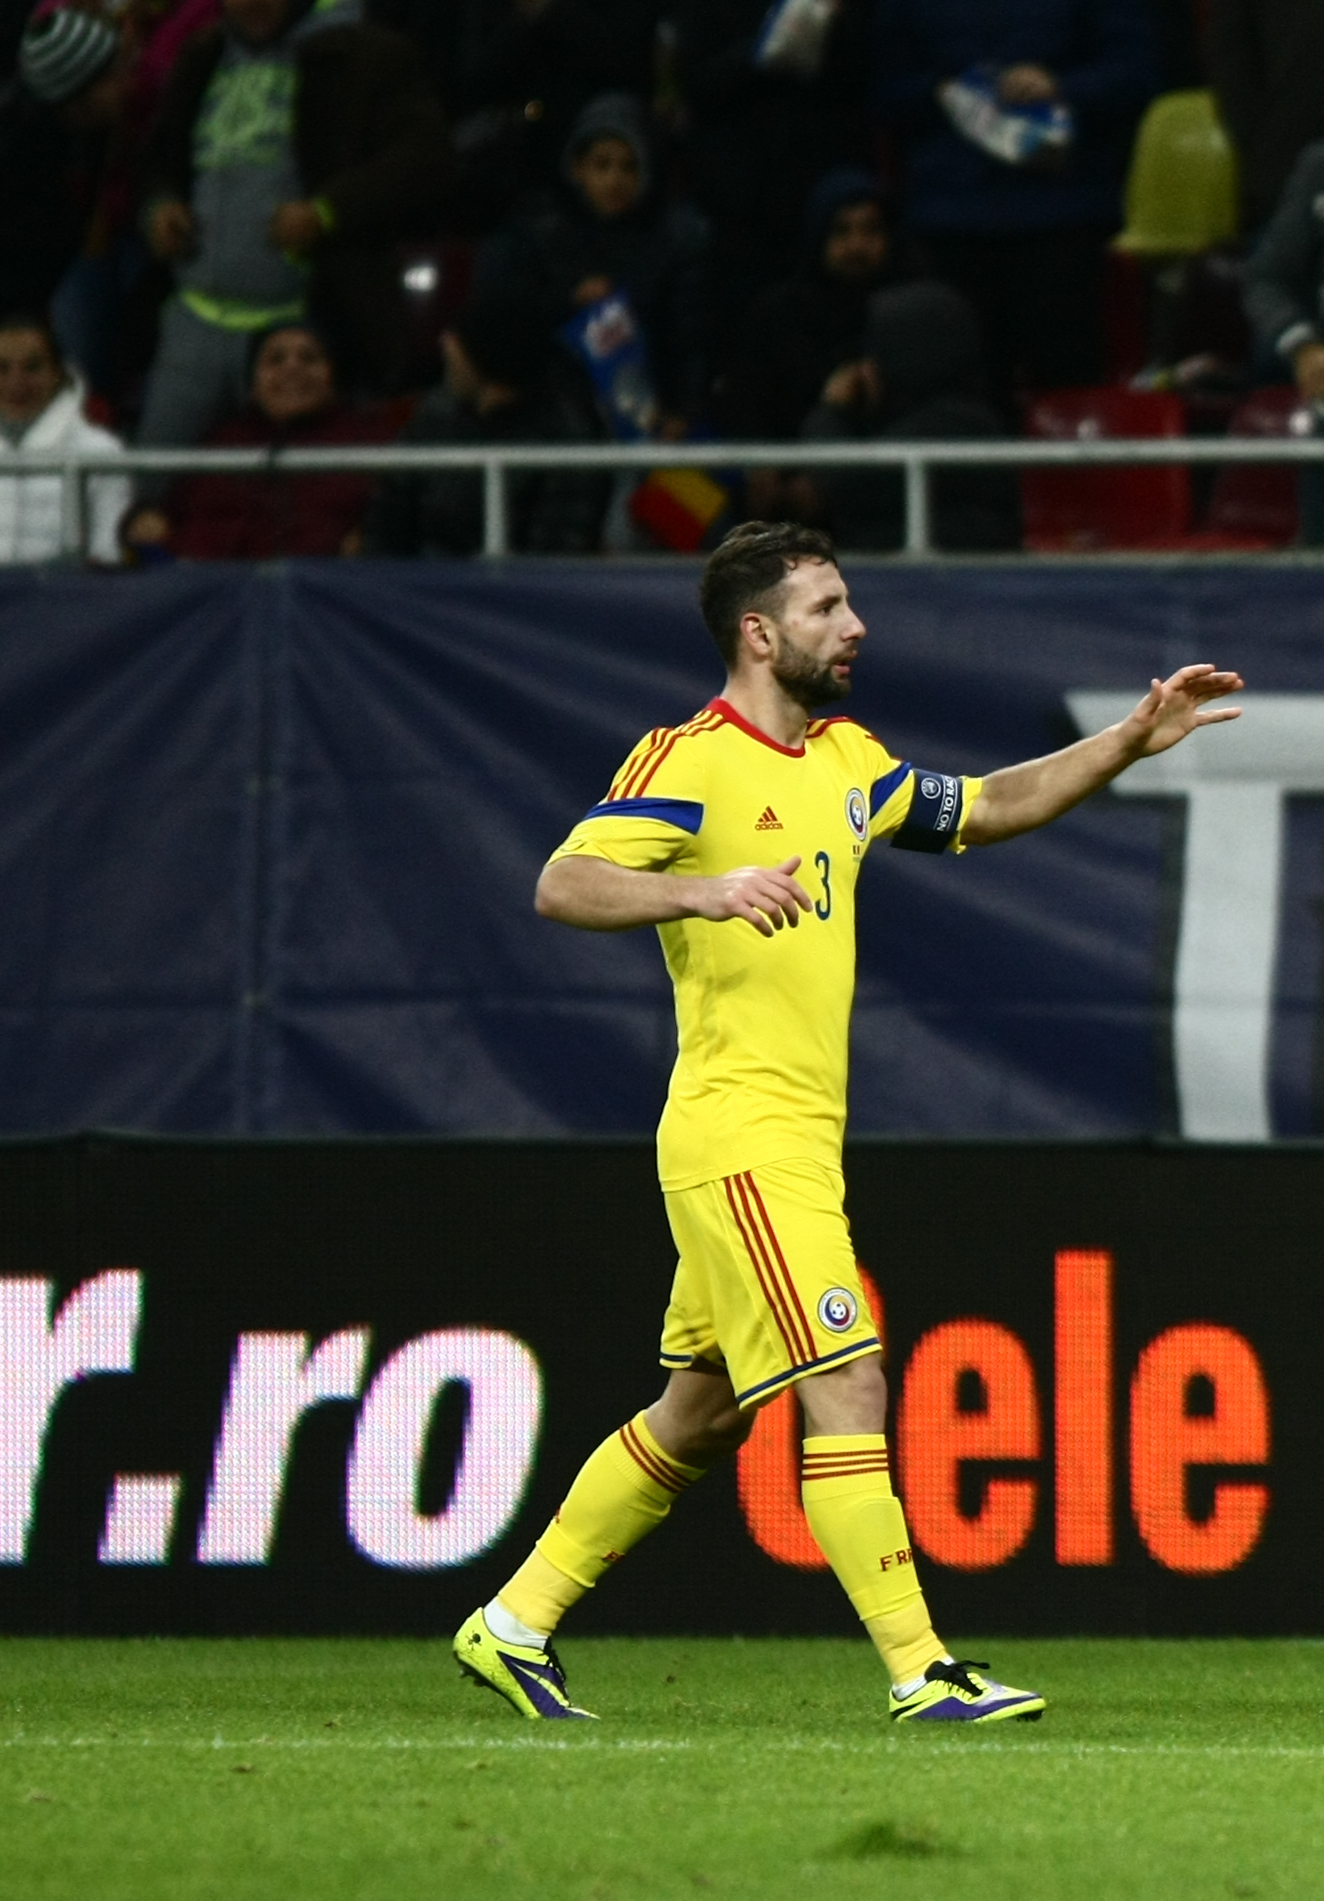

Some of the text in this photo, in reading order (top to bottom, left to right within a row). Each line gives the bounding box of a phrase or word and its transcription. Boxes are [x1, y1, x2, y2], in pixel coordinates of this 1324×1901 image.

[936, 814, 949, 831] NO
[943, 797, 953, 811] TO
[815, 851, 831, 920] 3
